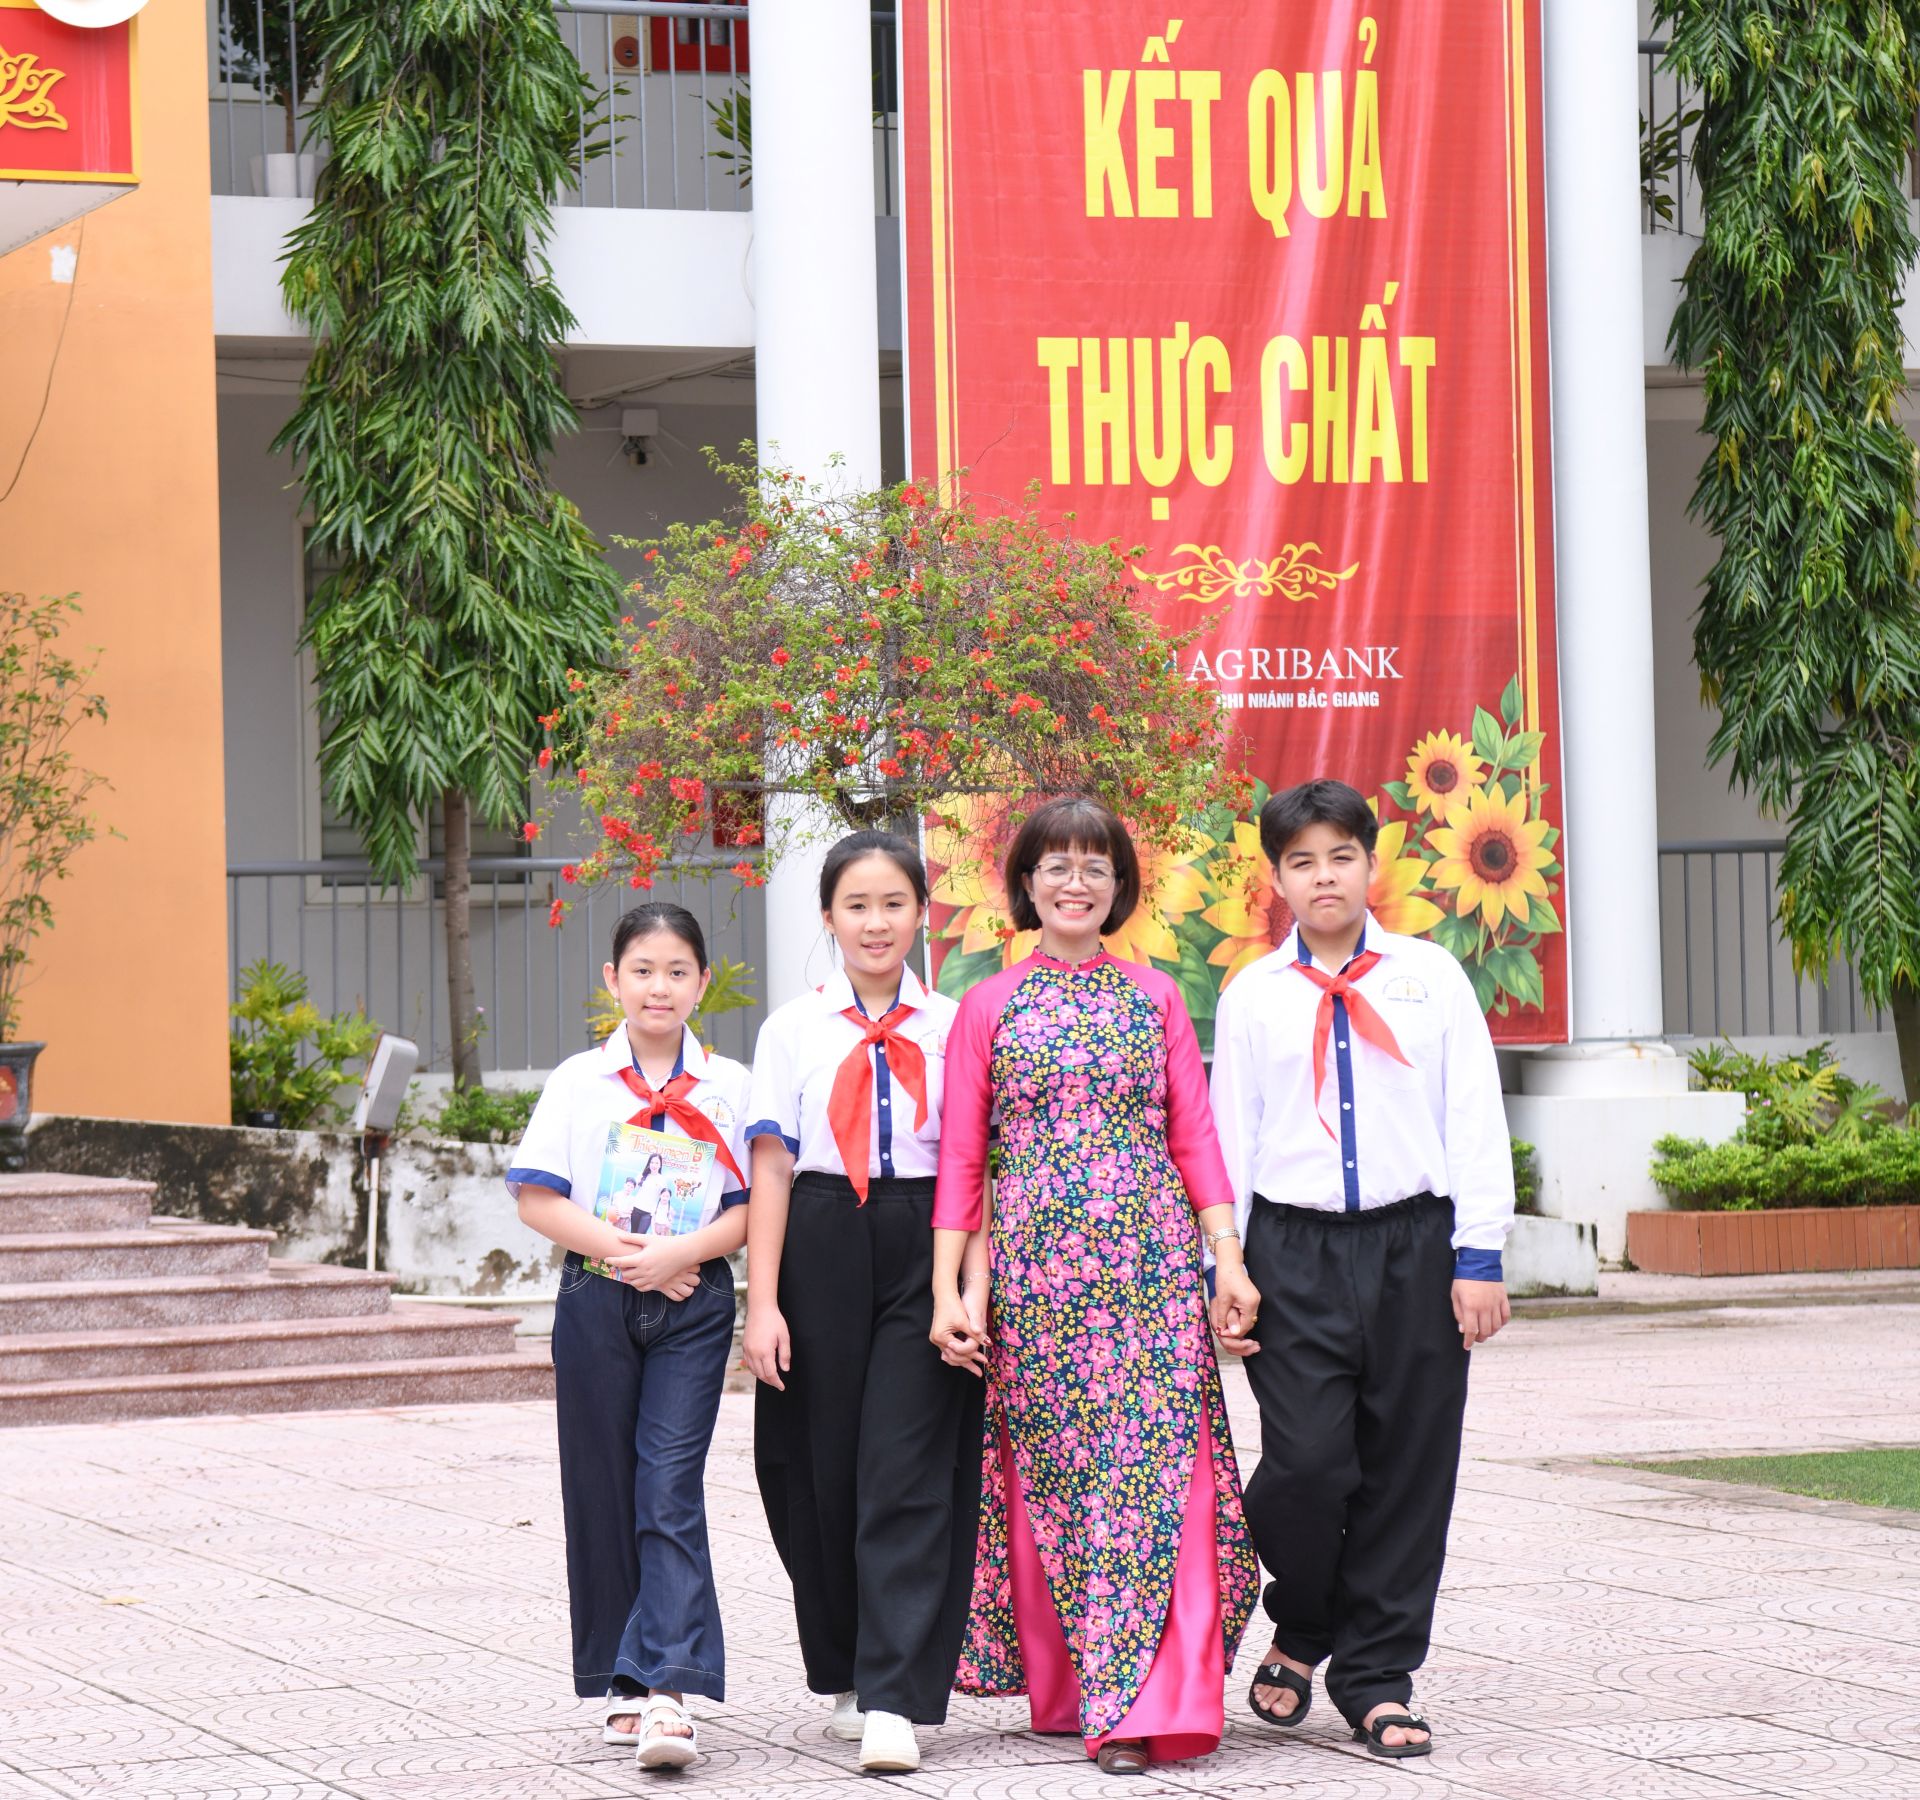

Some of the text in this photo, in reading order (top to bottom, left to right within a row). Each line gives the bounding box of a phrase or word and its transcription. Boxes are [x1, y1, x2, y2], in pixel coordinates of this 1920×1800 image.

[1083, 16, 1388, 239] KẾT QUẢ
[1037, 281, 1437, 521] THỰC CHẤT
[1186, 646, 1404, 682] AGRIBANK
[1248, 689, 1294, 709] NHÁNH
[1297, 687, 1328, 708] BẮC
[1332, 691, 1380, 708] GIANG
